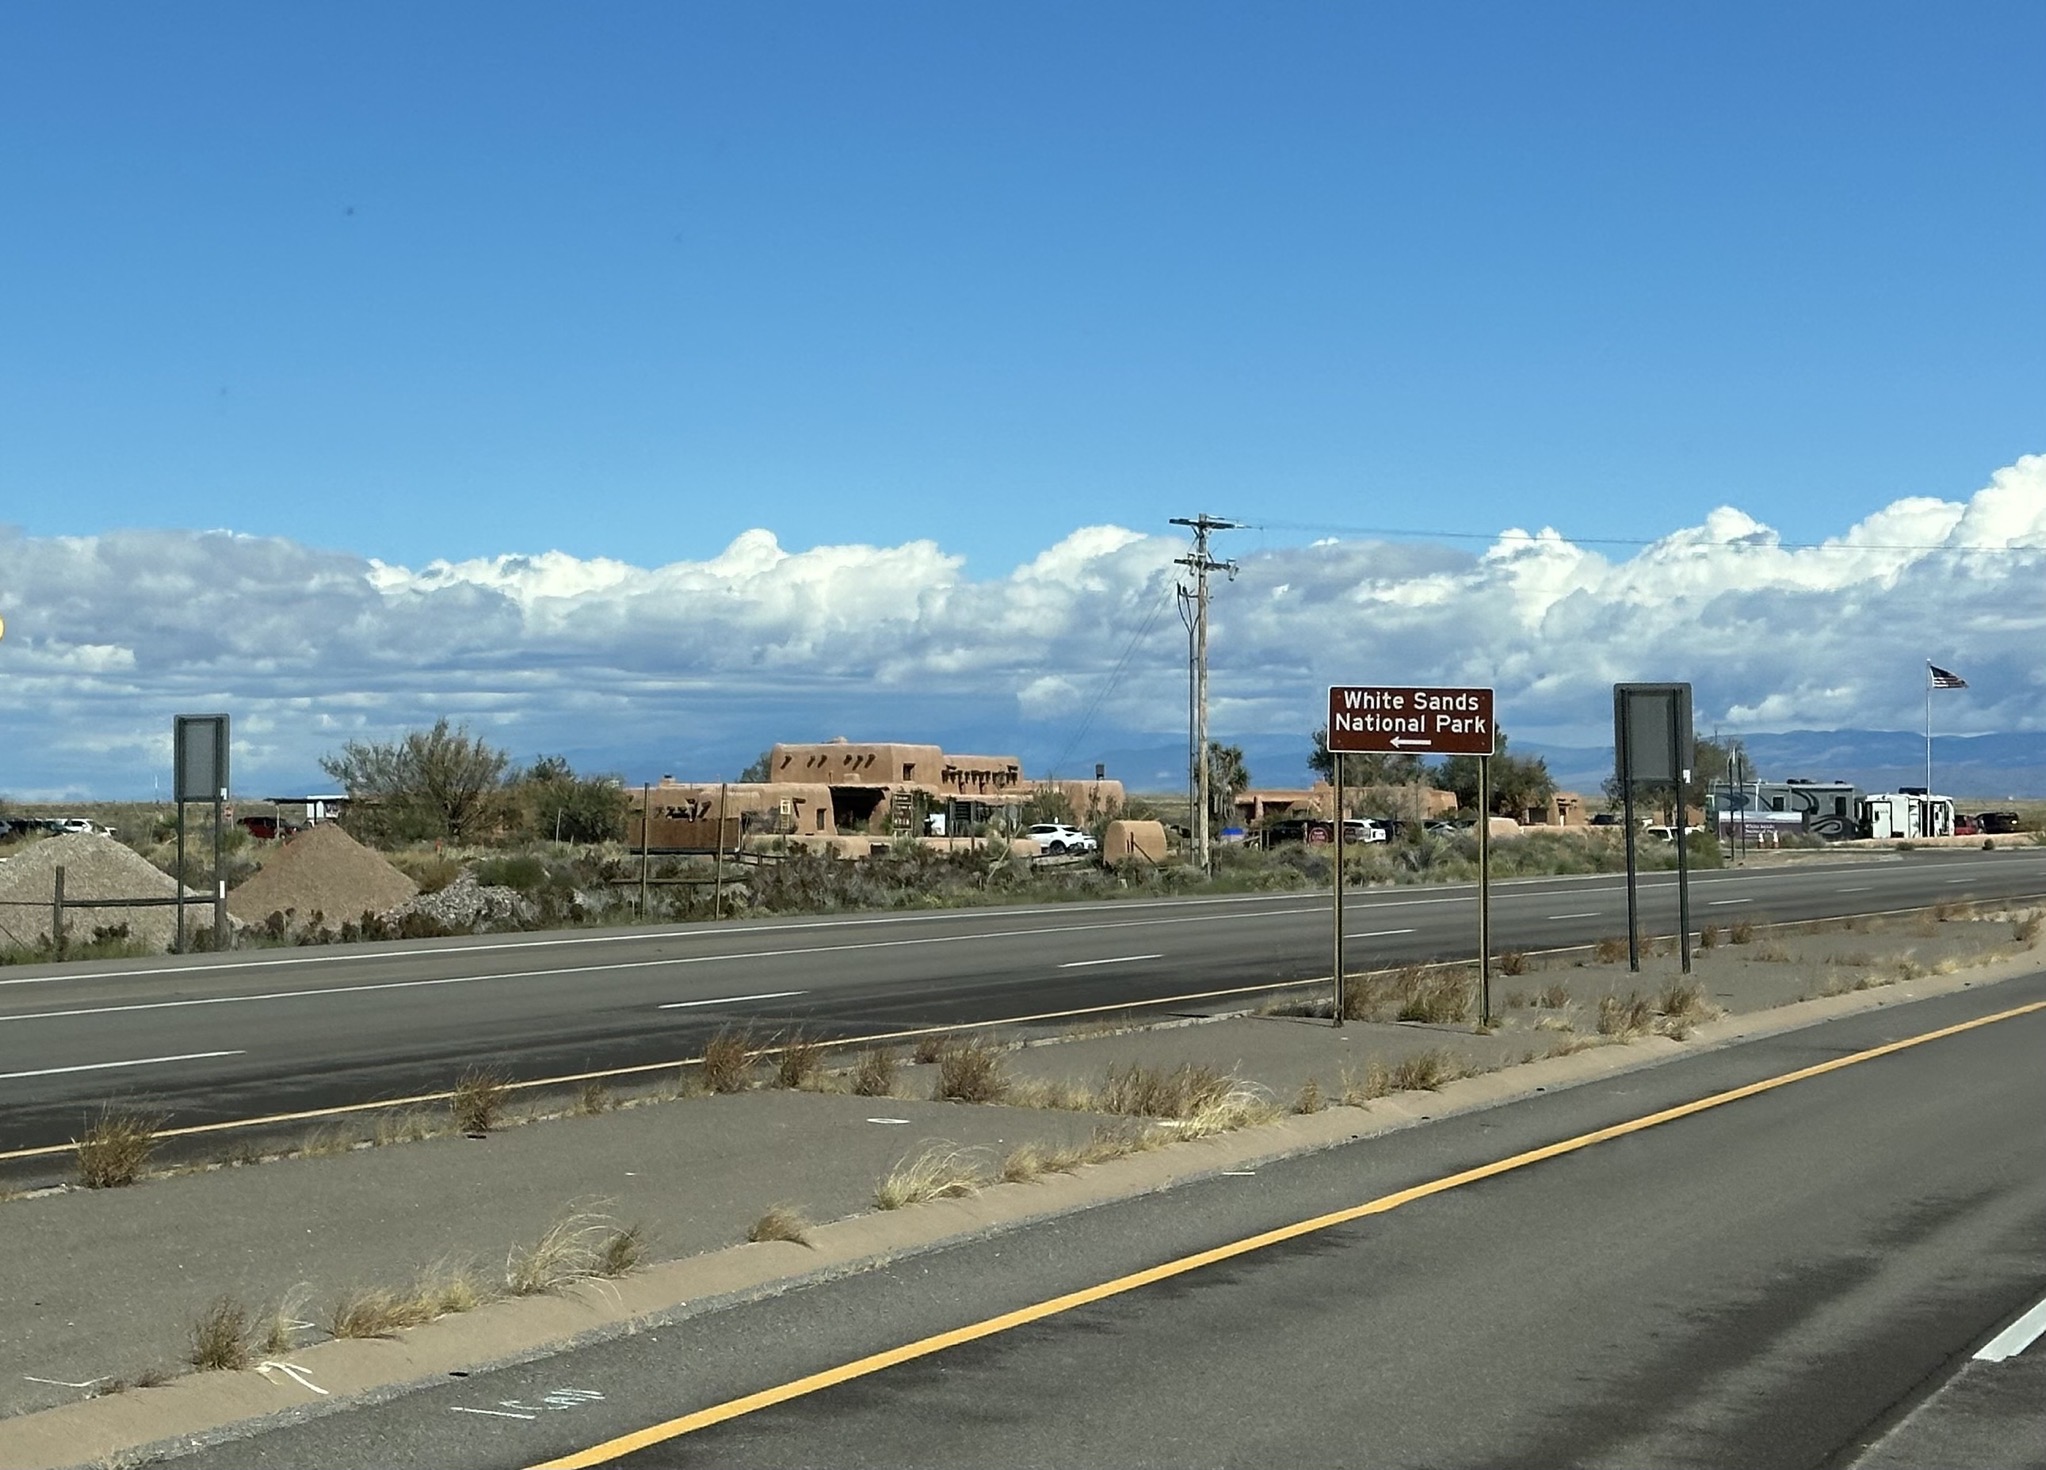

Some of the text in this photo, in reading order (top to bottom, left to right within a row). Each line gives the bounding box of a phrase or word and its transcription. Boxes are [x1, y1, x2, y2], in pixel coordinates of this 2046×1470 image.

[1344, 690, 1479, 711] White Sands
[1335, 713, 1486, 734] National Park
